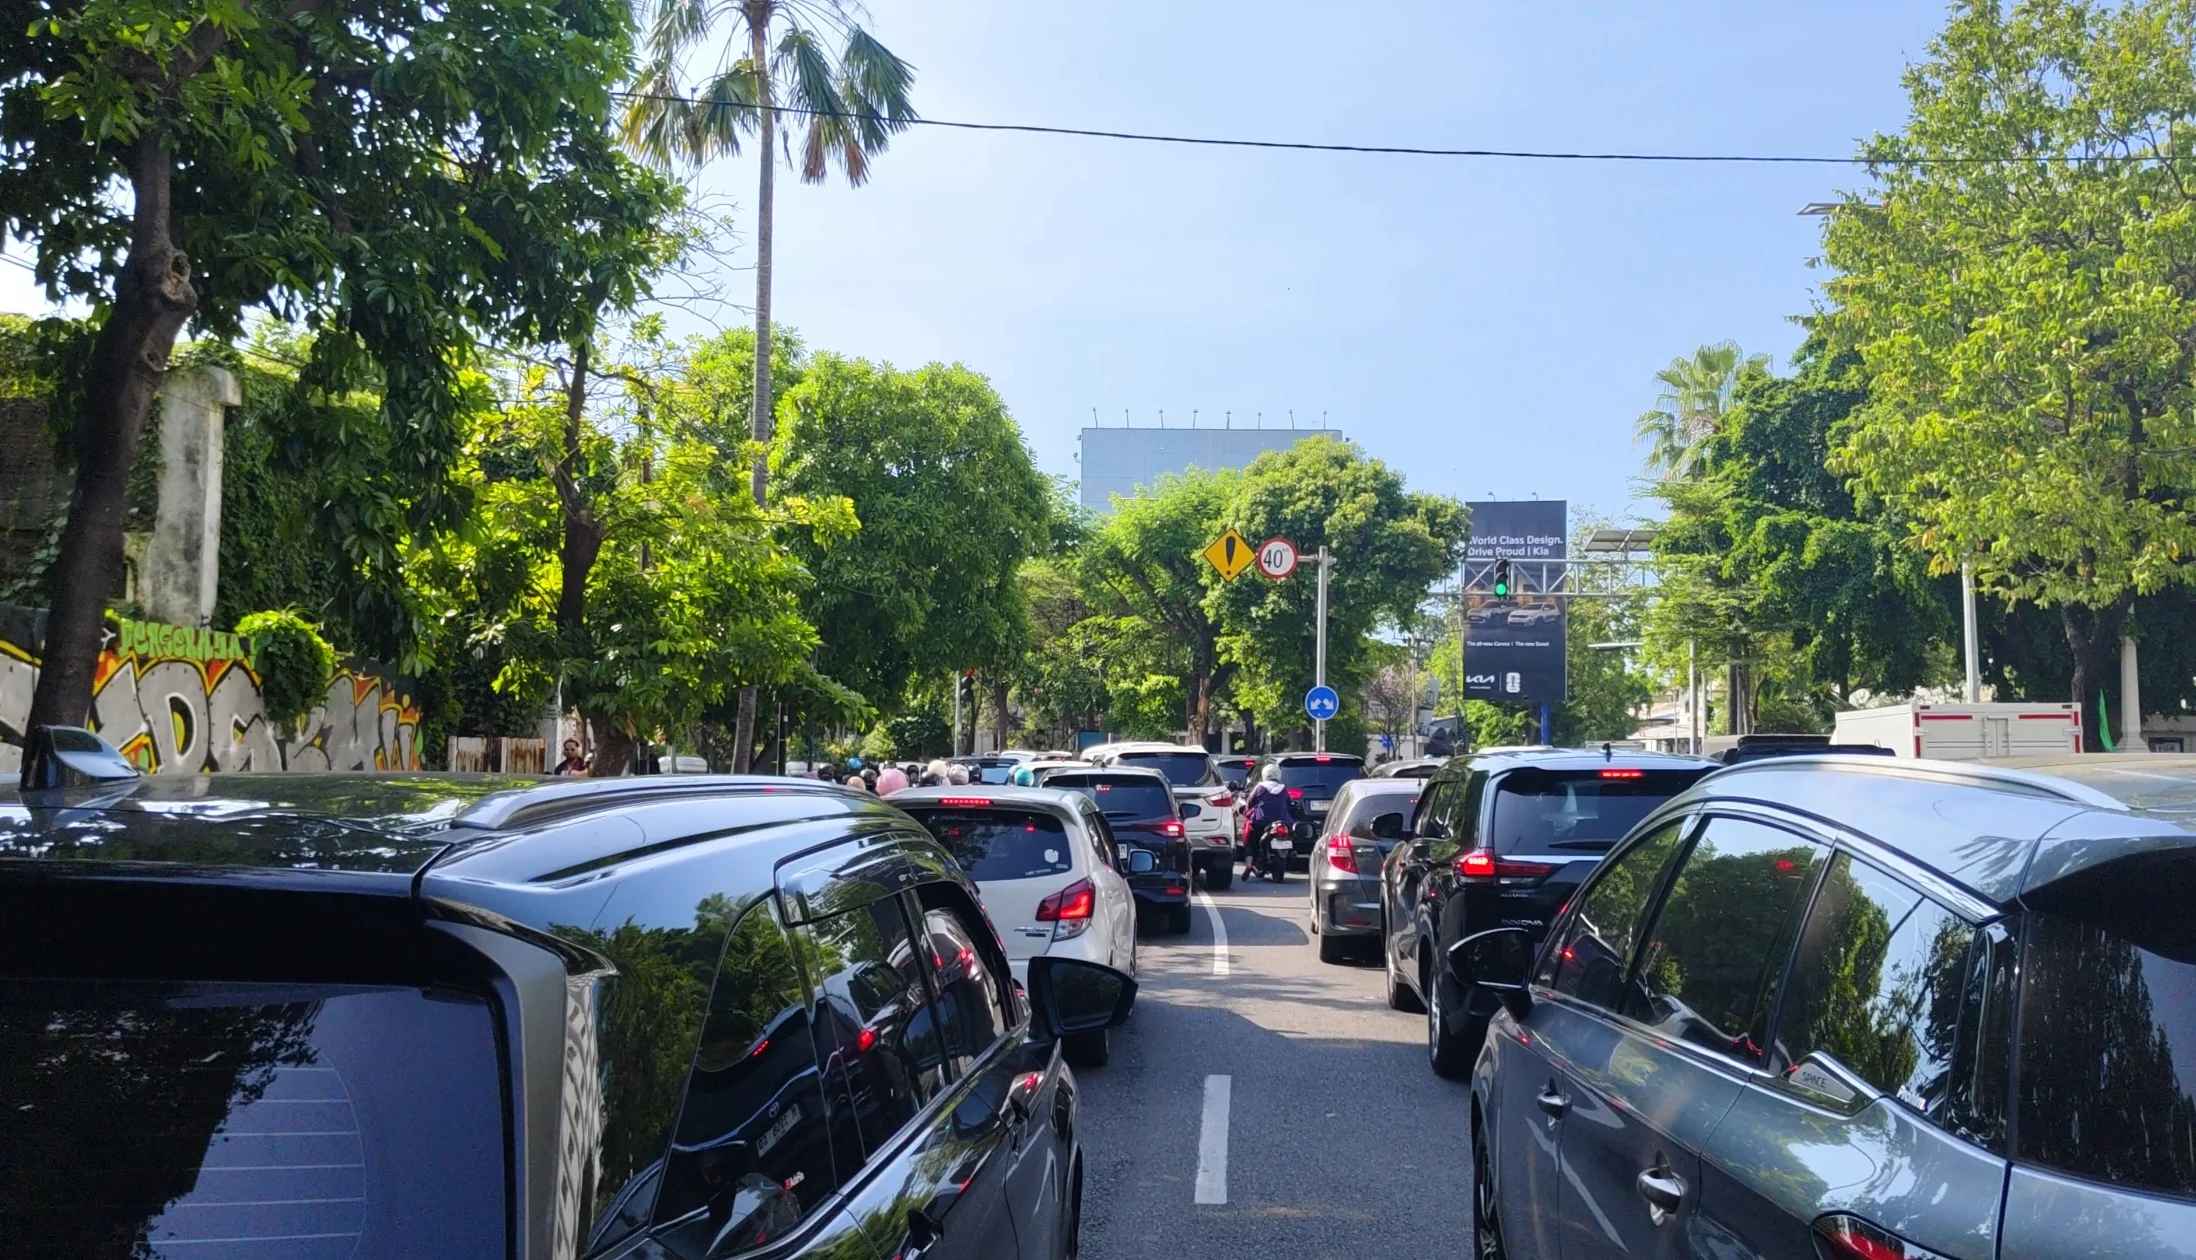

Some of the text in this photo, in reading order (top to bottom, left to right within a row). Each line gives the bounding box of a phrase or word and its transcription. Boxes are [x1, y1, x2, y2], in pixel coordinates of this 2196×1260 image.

[1469, 535, 1564, 546] World Class Design.
[1467, 547, 1493, 556] Drive
[1495, 546, 1525, 556] Proud
[1533, 546, 1549, 556] Kia
[1263, 549, 1283, 568] 40
